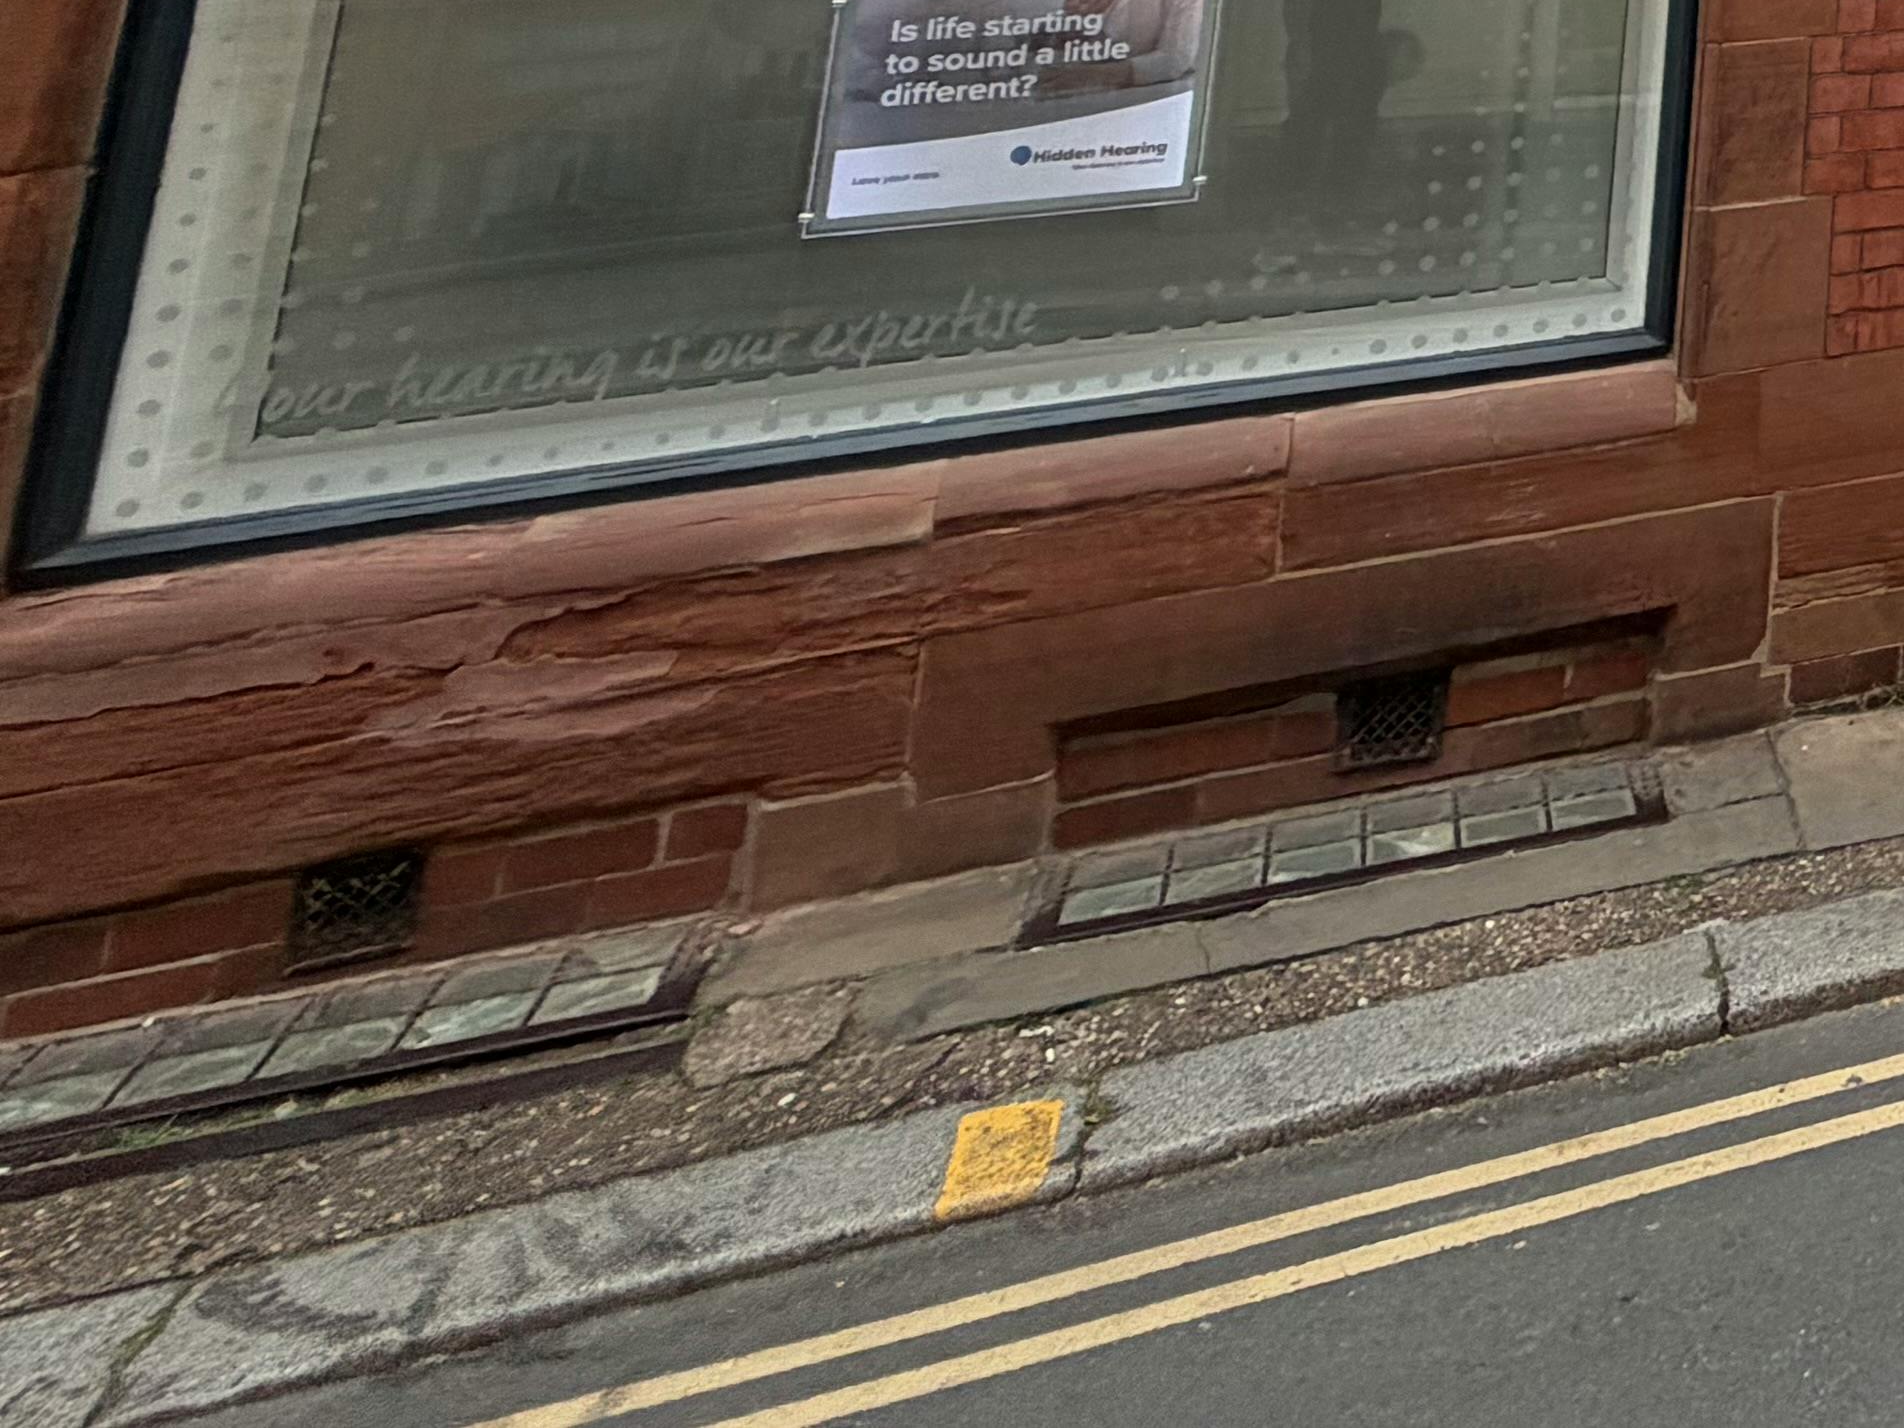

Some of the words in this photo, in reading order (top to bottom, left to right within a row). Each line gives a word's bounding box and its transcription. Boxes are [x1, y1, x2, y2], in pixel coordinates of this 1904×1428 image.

[891, 19, 919, 43] Is
[926, 16, 977, 41] life
[982, 10, 1103, 37] starting
[885, 53, 919, 75] to
[927, 45, 1028, 72] sound
[1034, 47, 1055, 66] a
[1063, 39, 1131, 63] little
[880, 75, 1038, 107] different?
[1033, 146, 1096, 164] Hidden
[1101, 141, 1168, 158] Hearing
[387, 347, 620, 409] hearing
[635, 331, 691, 379] is
[702, 329, 800, 372] our
[809, 284, 1040, 369] expertise
